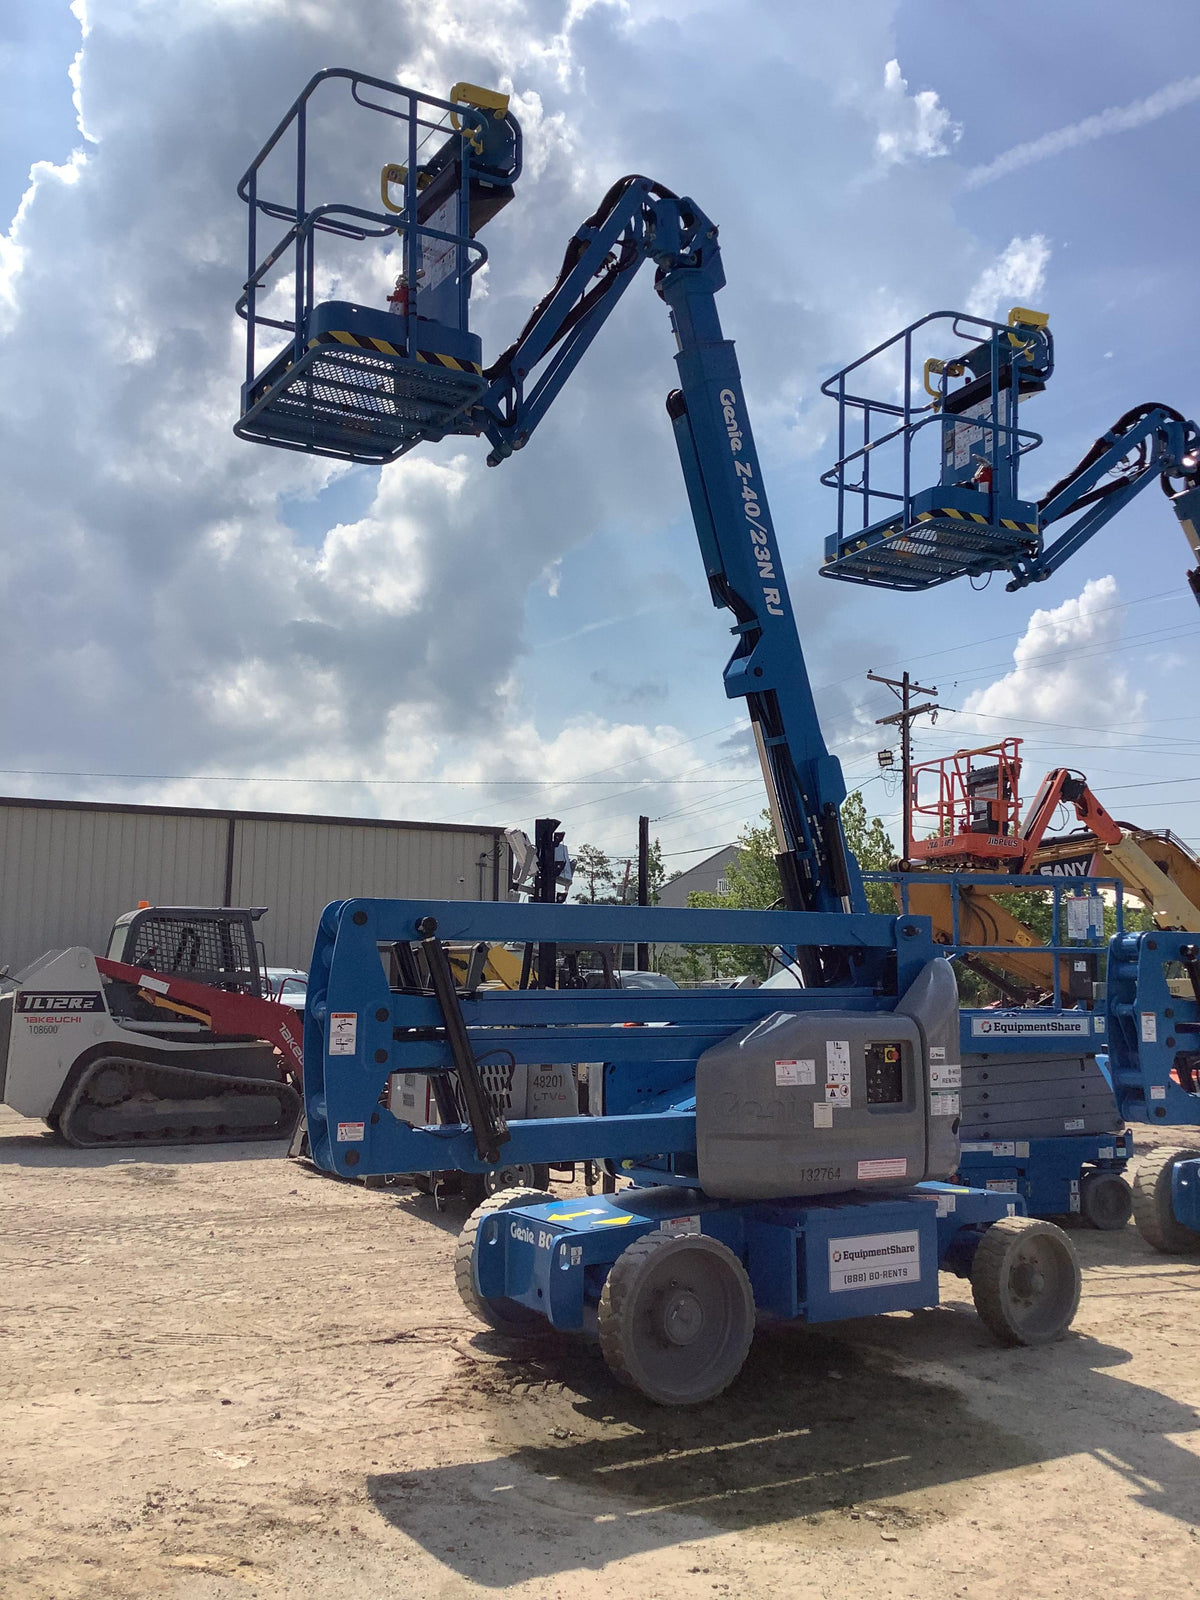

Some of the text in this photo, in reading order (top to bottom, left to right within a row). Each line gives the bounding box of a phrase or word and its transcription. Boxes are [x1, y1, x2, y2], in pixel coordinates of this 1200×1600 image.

[719, 387, 784, 616] Genie Z-40/23N RJ
[1040, 861, 1088, 876] SANY
[28, 1025, 58, 1034] 108600
[993, 1021, 1082, 1034] EquipmentShare
[533, 1075, 563, 1088] 48201
[800, 1167, 841, 1182] 132764
[510, 1221, 536, 1245] Genie
[843, 1244, 916, 1261] EquipmentShare
[843, 1272, 867, 1285] (888)
